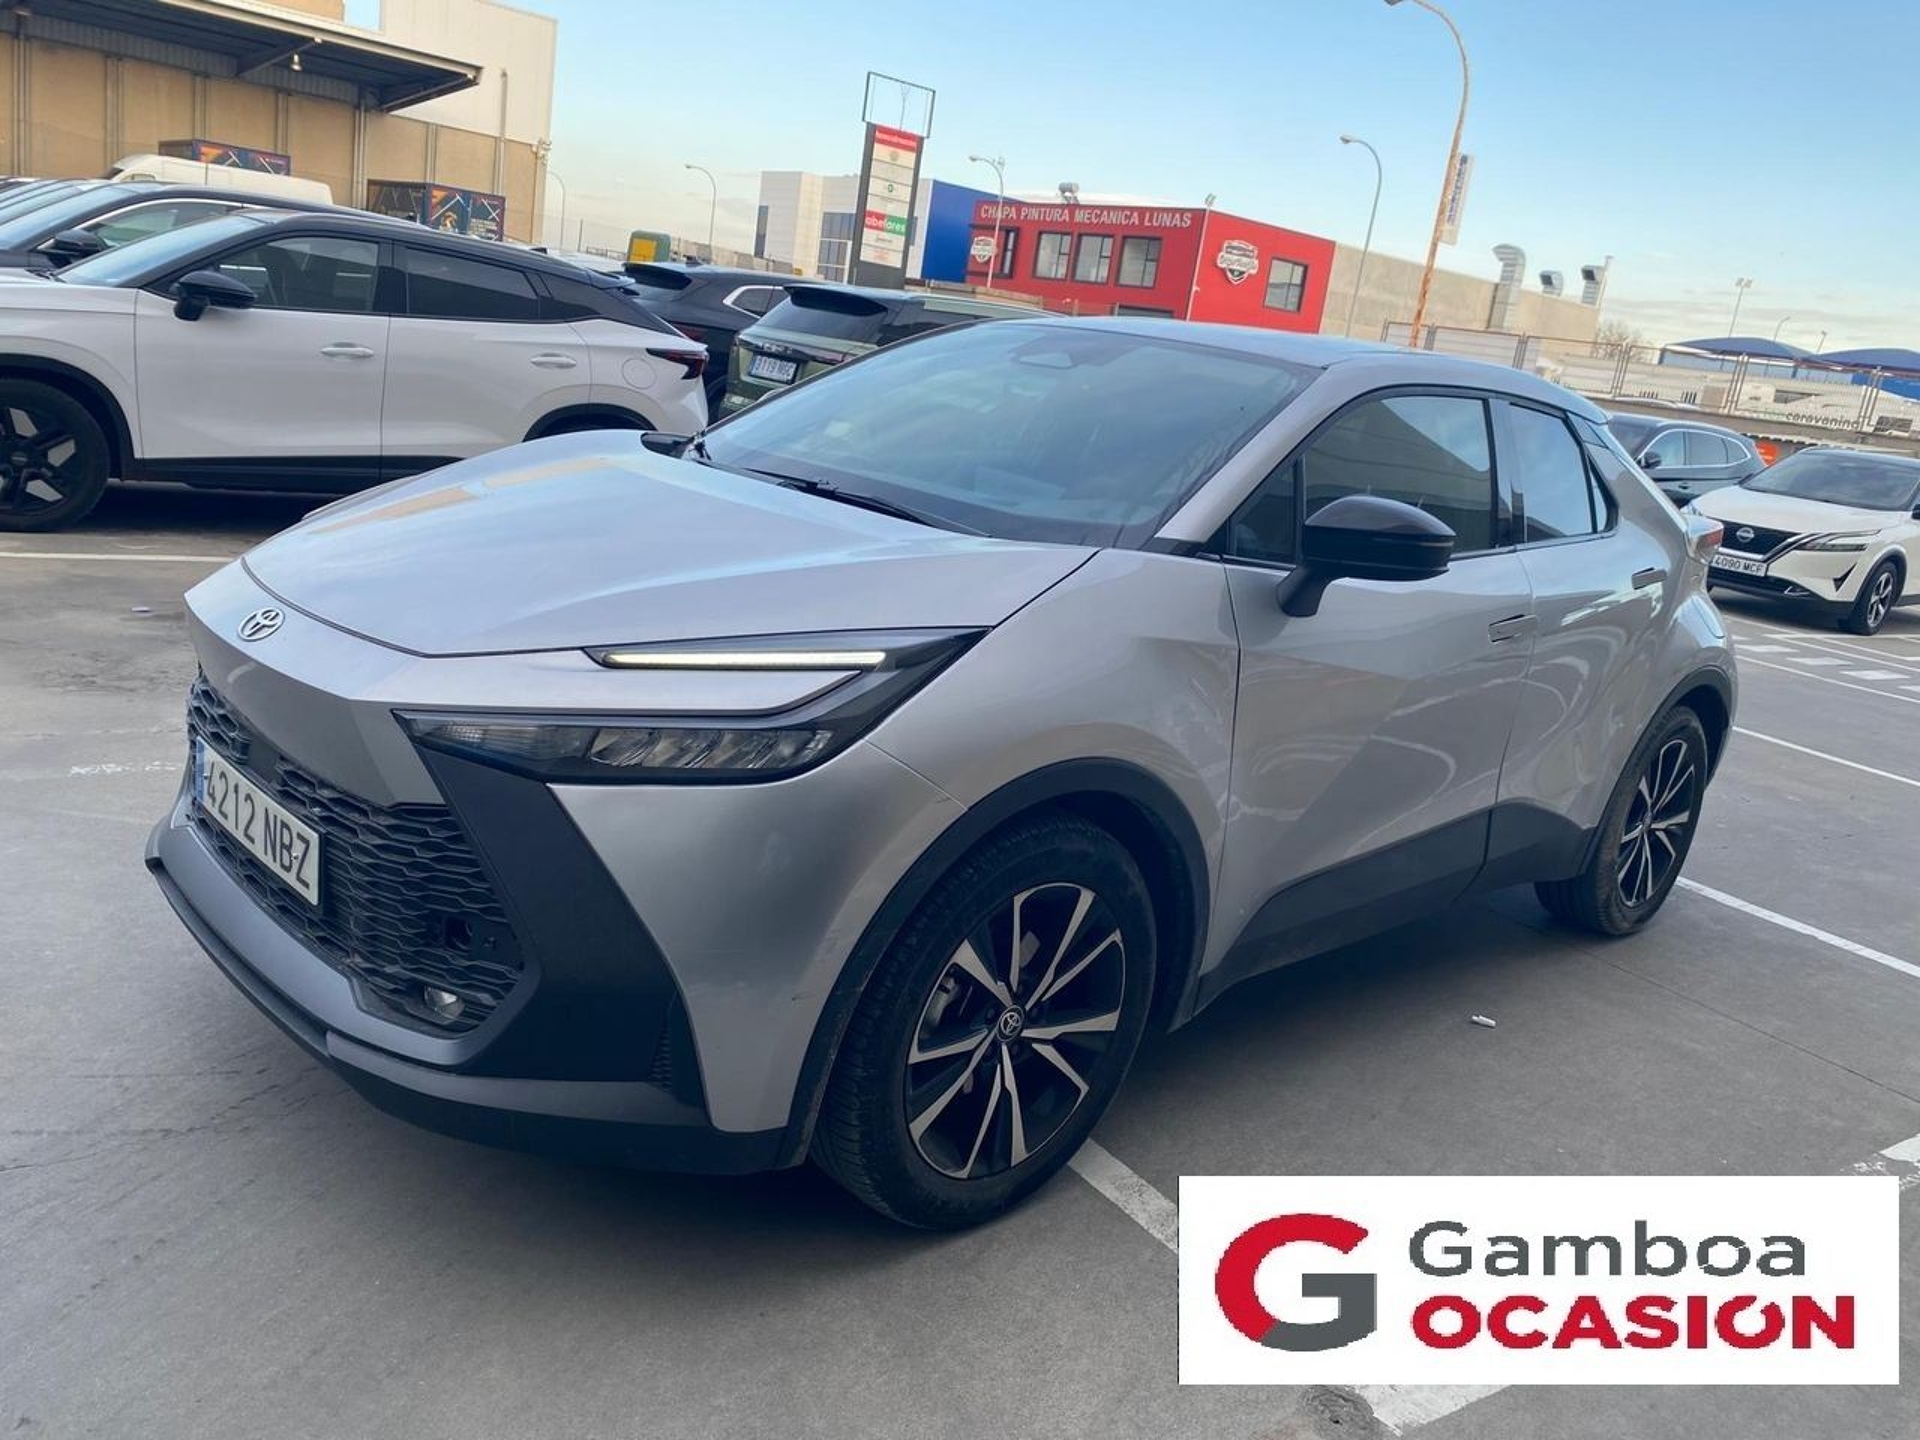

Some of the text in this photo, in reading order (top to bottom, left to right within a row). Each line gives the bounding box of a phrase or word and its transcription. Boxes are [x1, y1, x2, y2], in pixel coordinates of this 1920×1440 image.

[1020, 207, 1069, 222] PINTURA
[1074, 208, 1139, 226] MECANICA
[1144, 212, 1192, 228] LUNAS
[207, 761, 310, 890] 4212 NBZ
